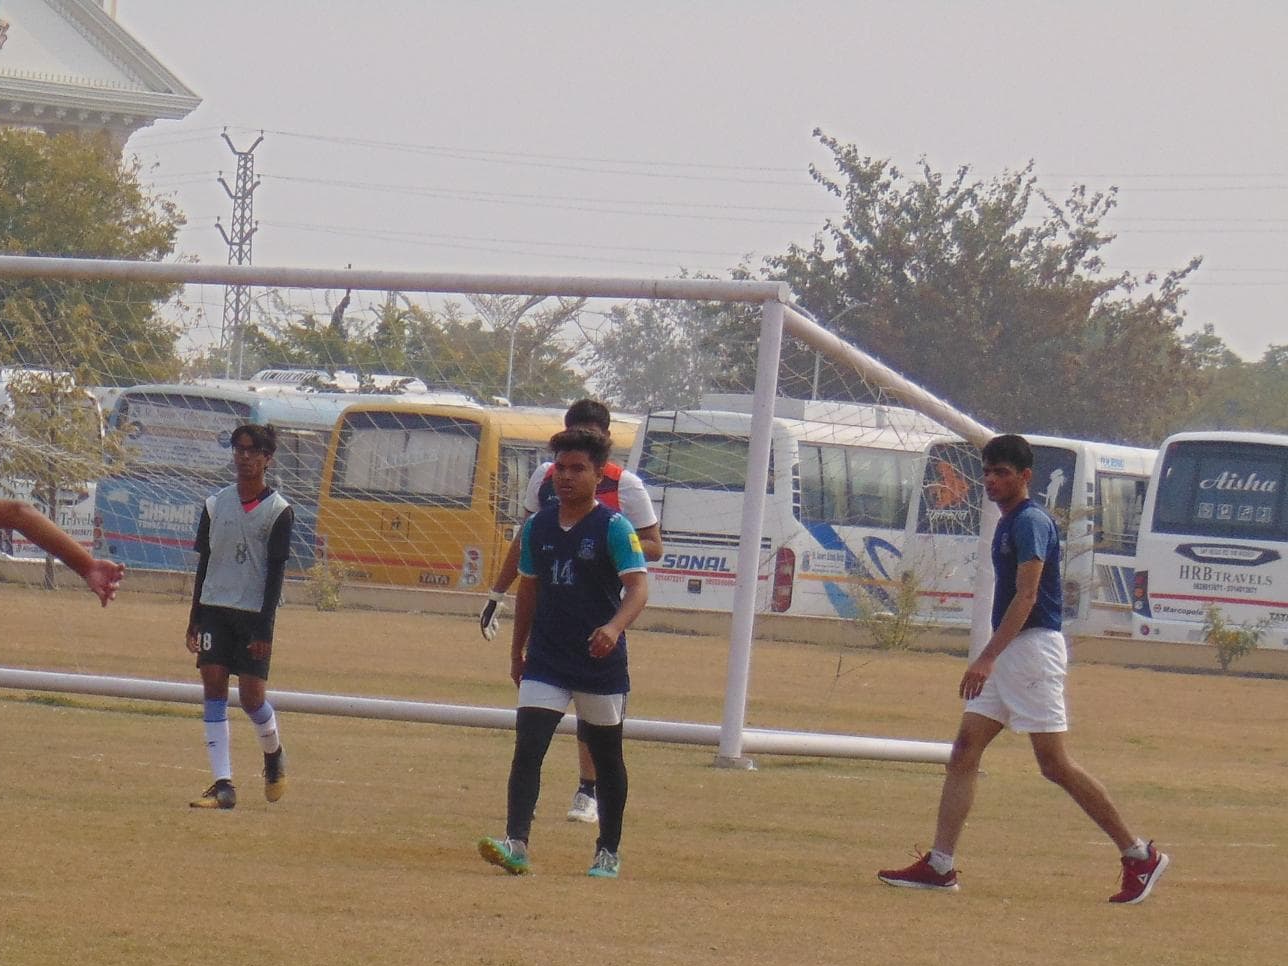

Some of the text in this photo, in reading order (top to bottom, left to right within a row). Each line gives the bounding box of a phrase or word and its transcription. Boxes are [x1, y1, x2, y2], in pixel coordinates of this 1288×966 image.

[1199, 471, 1277, 493] Aisha
[550, 559, 575, 585] 14
[662, 553, 730, 572] SONAL
[1179, 564, 1273, 586] HRB TRAVELS
